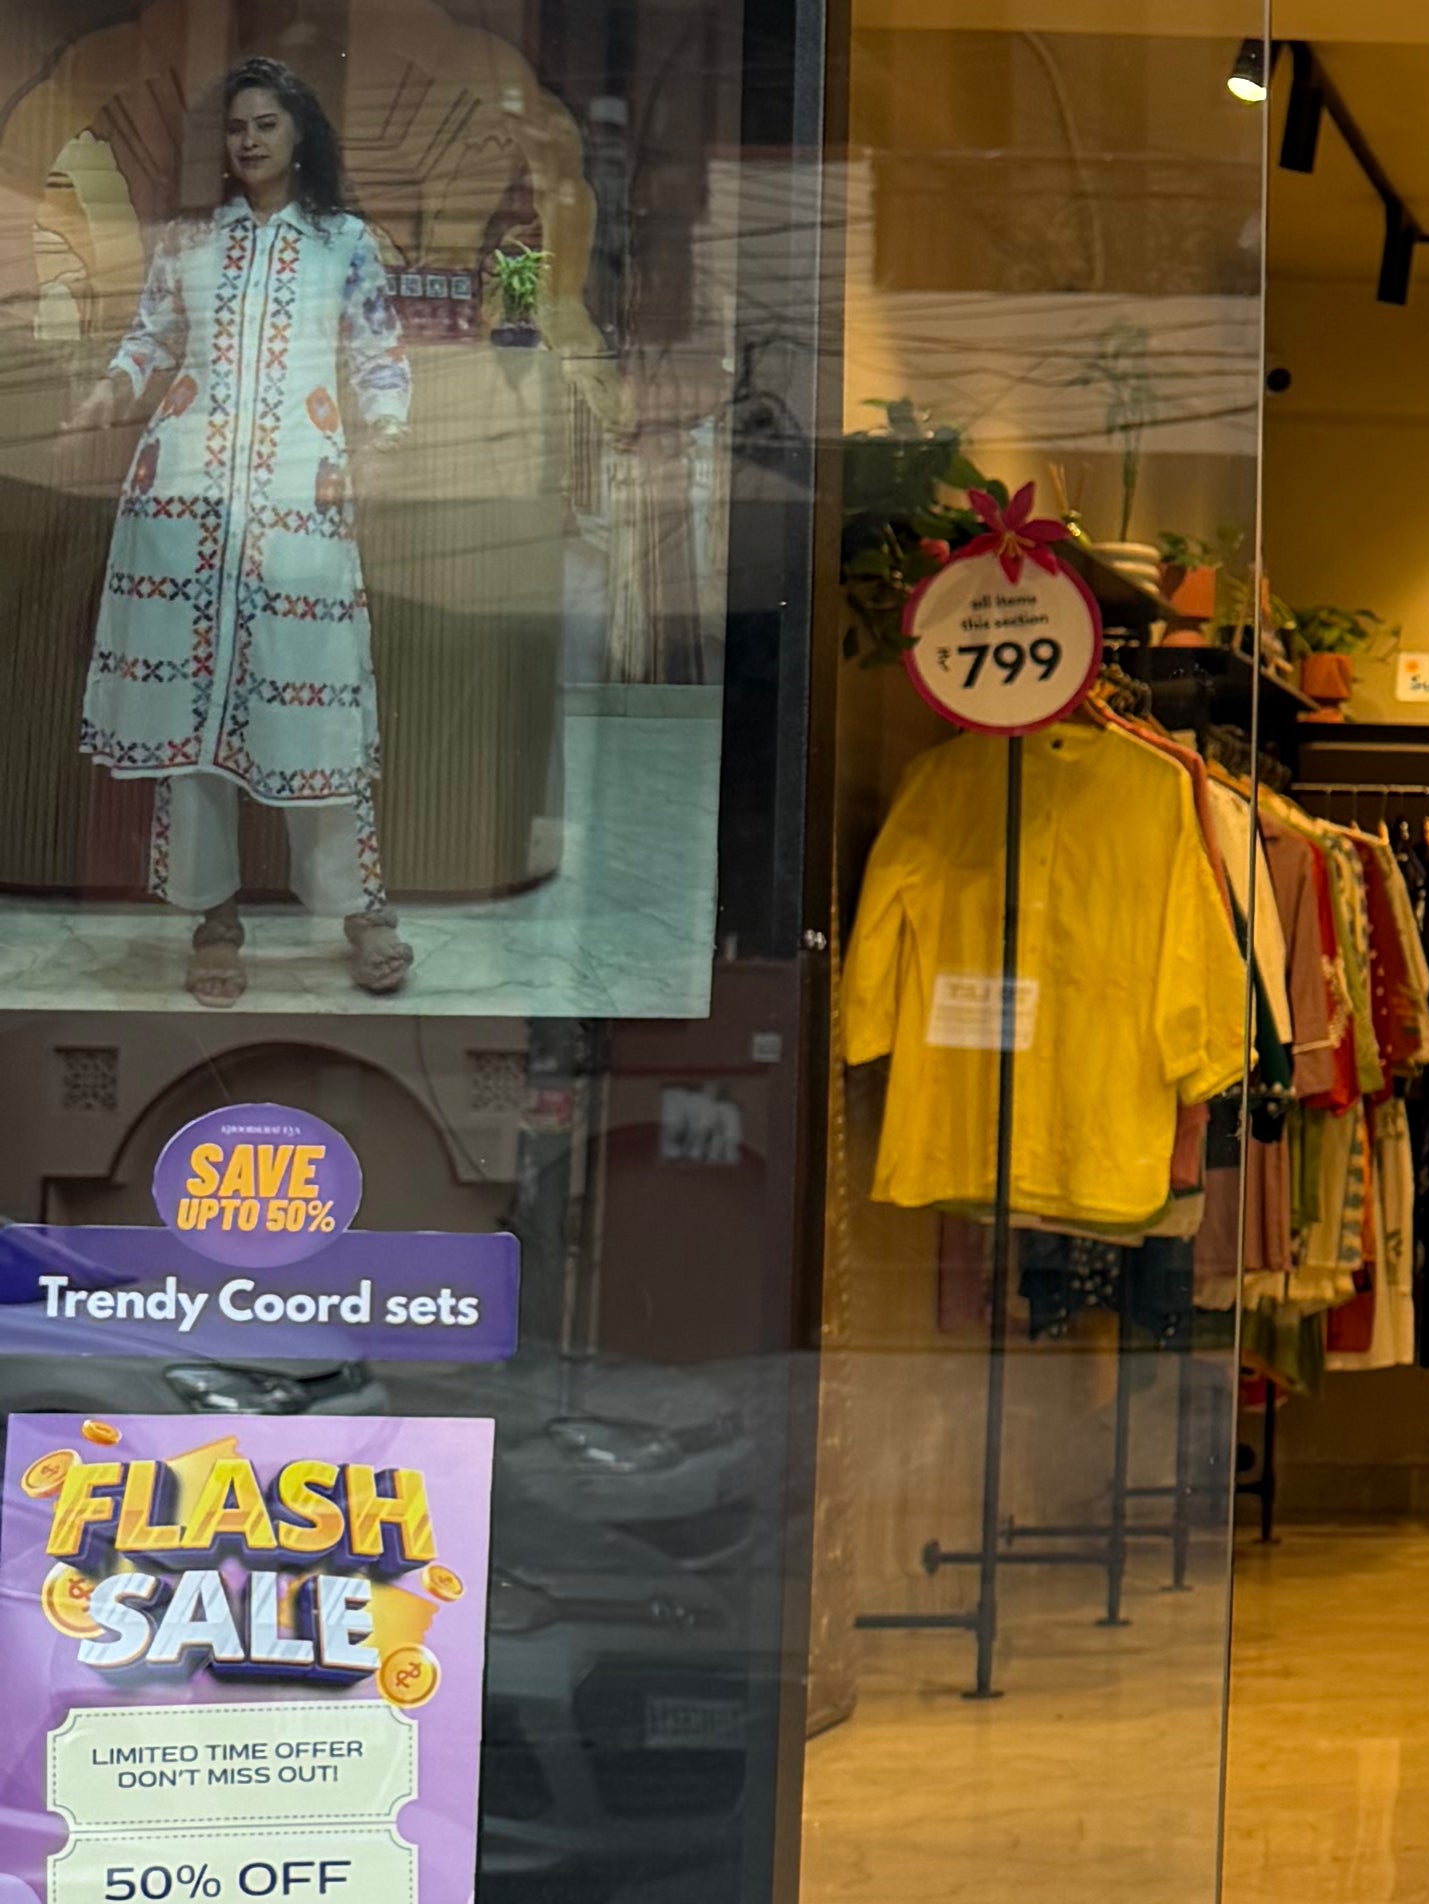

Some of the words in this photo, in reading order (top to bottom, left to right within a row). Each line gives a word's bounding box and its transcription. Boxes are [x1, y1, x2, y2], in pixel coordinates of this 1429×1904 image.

[186, 1143, 326, 1199] SAVE
[177, 1198, 260, 1232] UPTO
[265, 1199, 336, 1233] 50%
[38, 1275, 208, 1332] Trendy
[218, 1278, 371, 1324] Coord
[384, 1288, 480, 1326] sets
[46, 1458, 438, 1561] FLASH
[77, 1570, 381, 1671] SALE
[91, 1745, 199, 1766] LIMITED
[205, 1742, 268, 1763] TIME
[274, 1740, 364, 1760] OFFER
[117, 1769, 201, 1789] DON'T
[207, 1767, 271, 1786] MISS
[277, 1765, 339, 1784] OUT!
[104, 1863, 222, 1902] 50%
[238, 1860, 352, 1897] OFF
